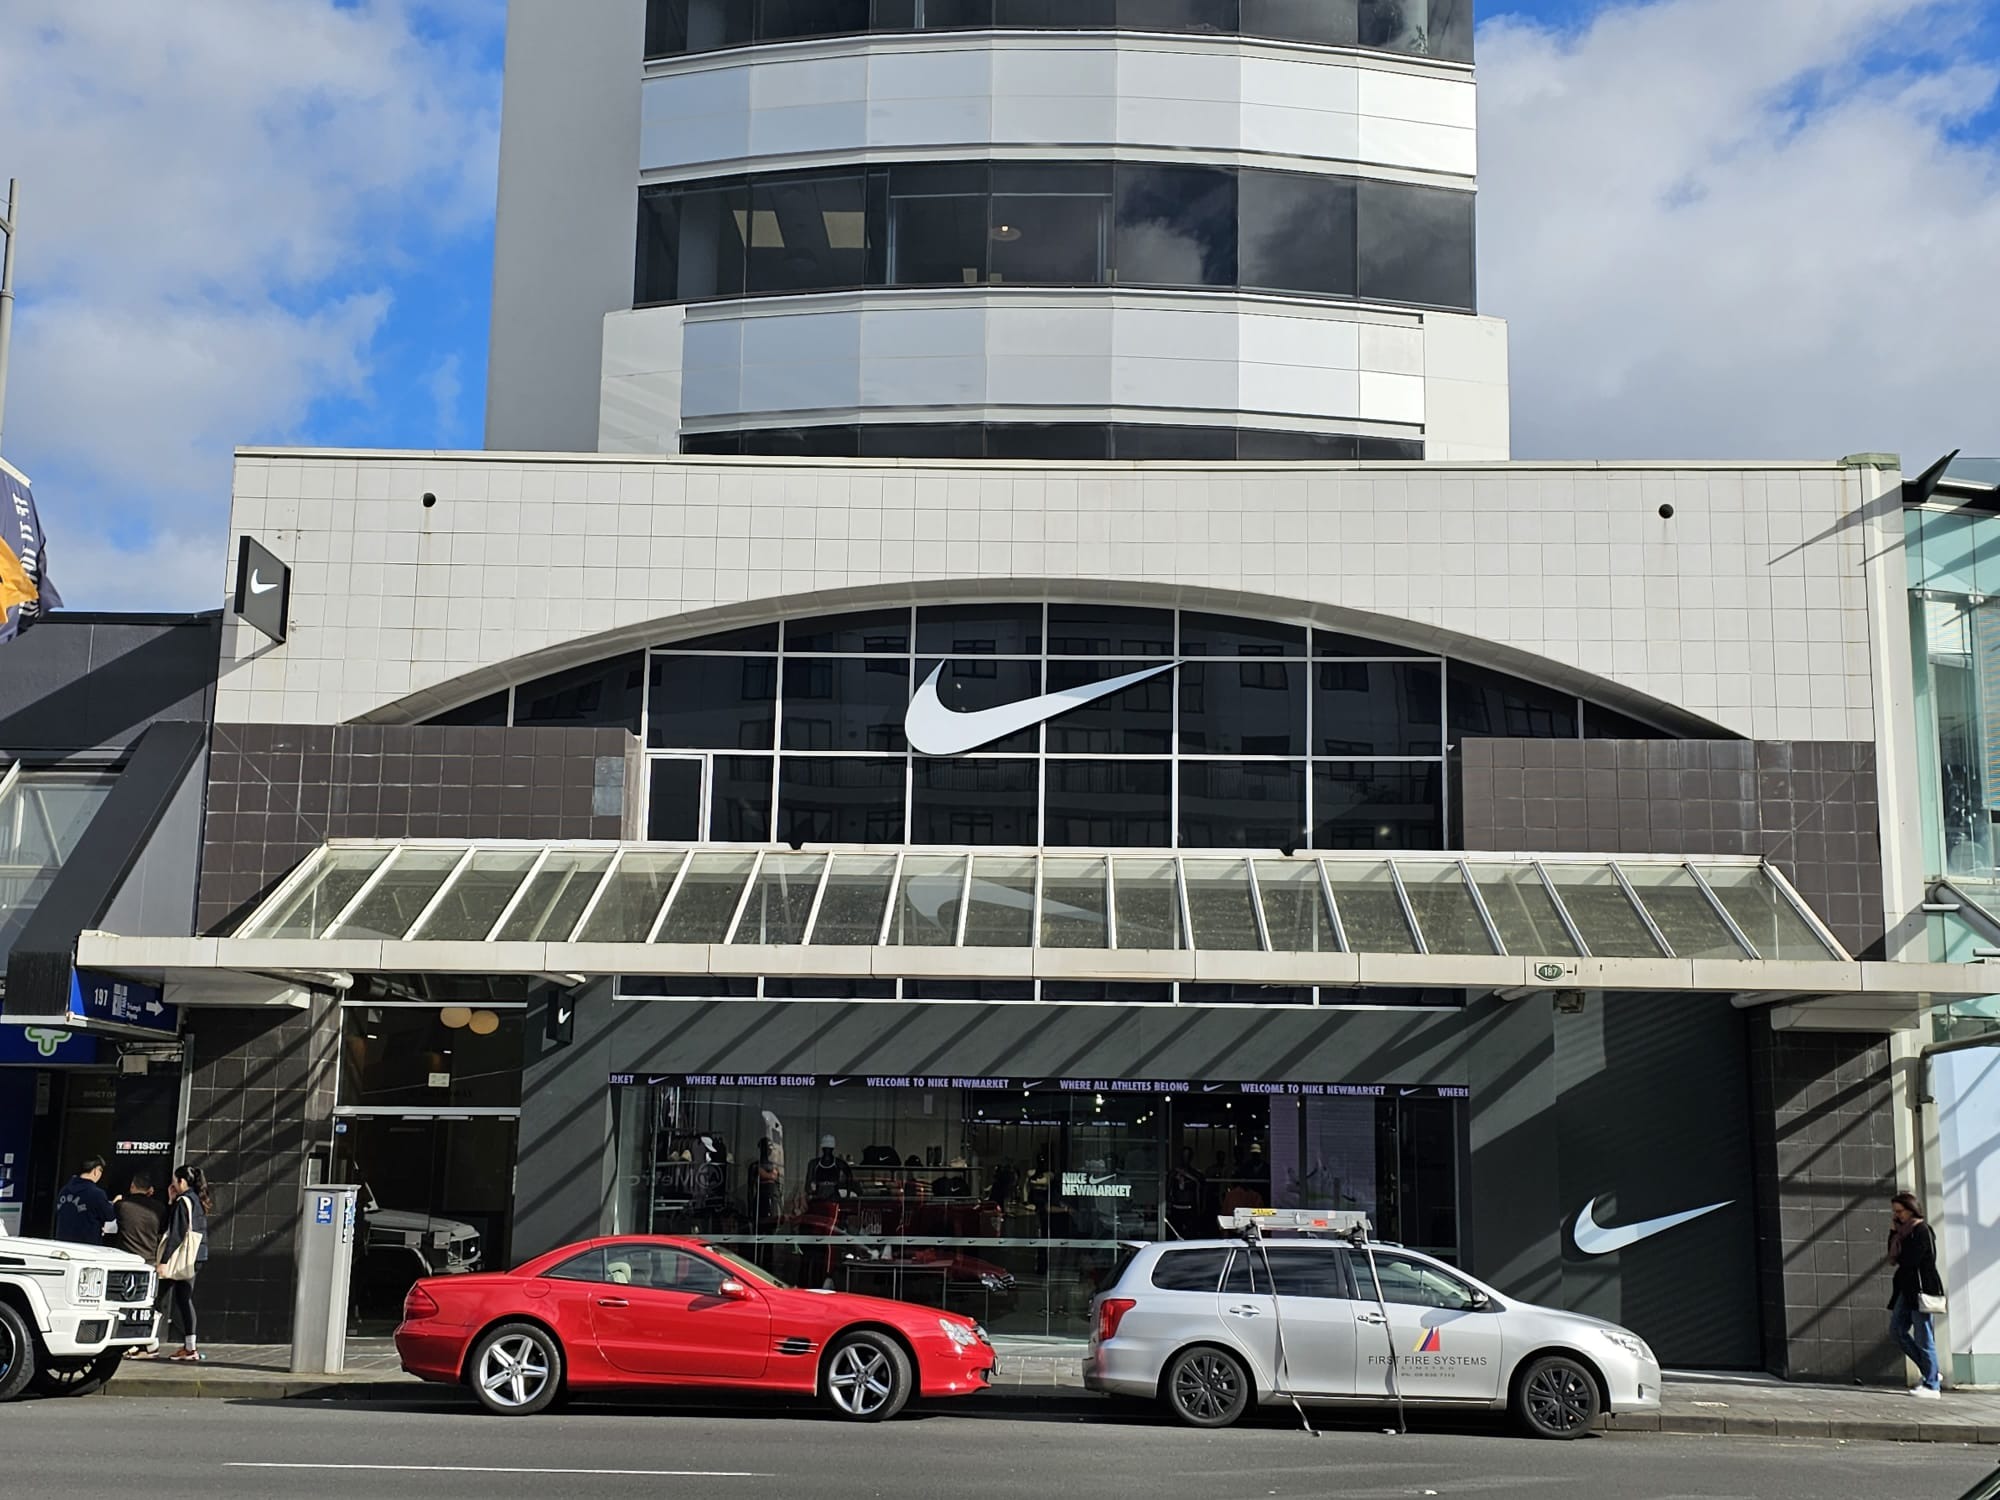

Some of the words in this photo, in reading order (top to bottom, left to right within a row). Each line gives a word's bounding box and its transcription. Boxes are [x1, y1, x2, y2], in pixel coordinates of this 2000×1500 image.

[1544, 967, 1558, 977] 187
[94, 987, 108, 1006] 197
[685, 1076, 717, 1085] WHERE
[720, 1076, 735, 1085] ALL
[737, 1076, 778, 1085] ATHLETES
[780, 1077, 816, 1086] BELONG
[866, 1077, 910, 1087] WELCOME
[913, 1078, 925, 1087] TO
[928, 1078, 949, 1088] NIKE
[952, 1078, 1009, 1088] NEWMARKET
[1060, 1080, 1092, 1090] WHERE
[1093, 1081, 1109, 1090] ALL
[1111, 1081, 1152, 1091] ATHLETES
[1154, 1082, 1190, 1092] BELONG
[1240, 1083, 1284, 1093] WELCOME
[1288, 1084, 1299, 1093] TO
[1302, 1084, 1324, 1094] NIKE
[1327, 1085, 1386, 1095] NEWMARKET
[132, 1141, 171, 1150] TISSOT
[1062, 1172, 1088, 1184] NIKE
[1061, 1184, 1132, 1197] NEWMARKET
[320, 1197, 332, 1210] P
[1368, 1355, 1401, 1366] FIRST
[1404, 1355, 1431, 1366] FIRE
[1433, 1356, 1488, 1366] SYSTEMS
